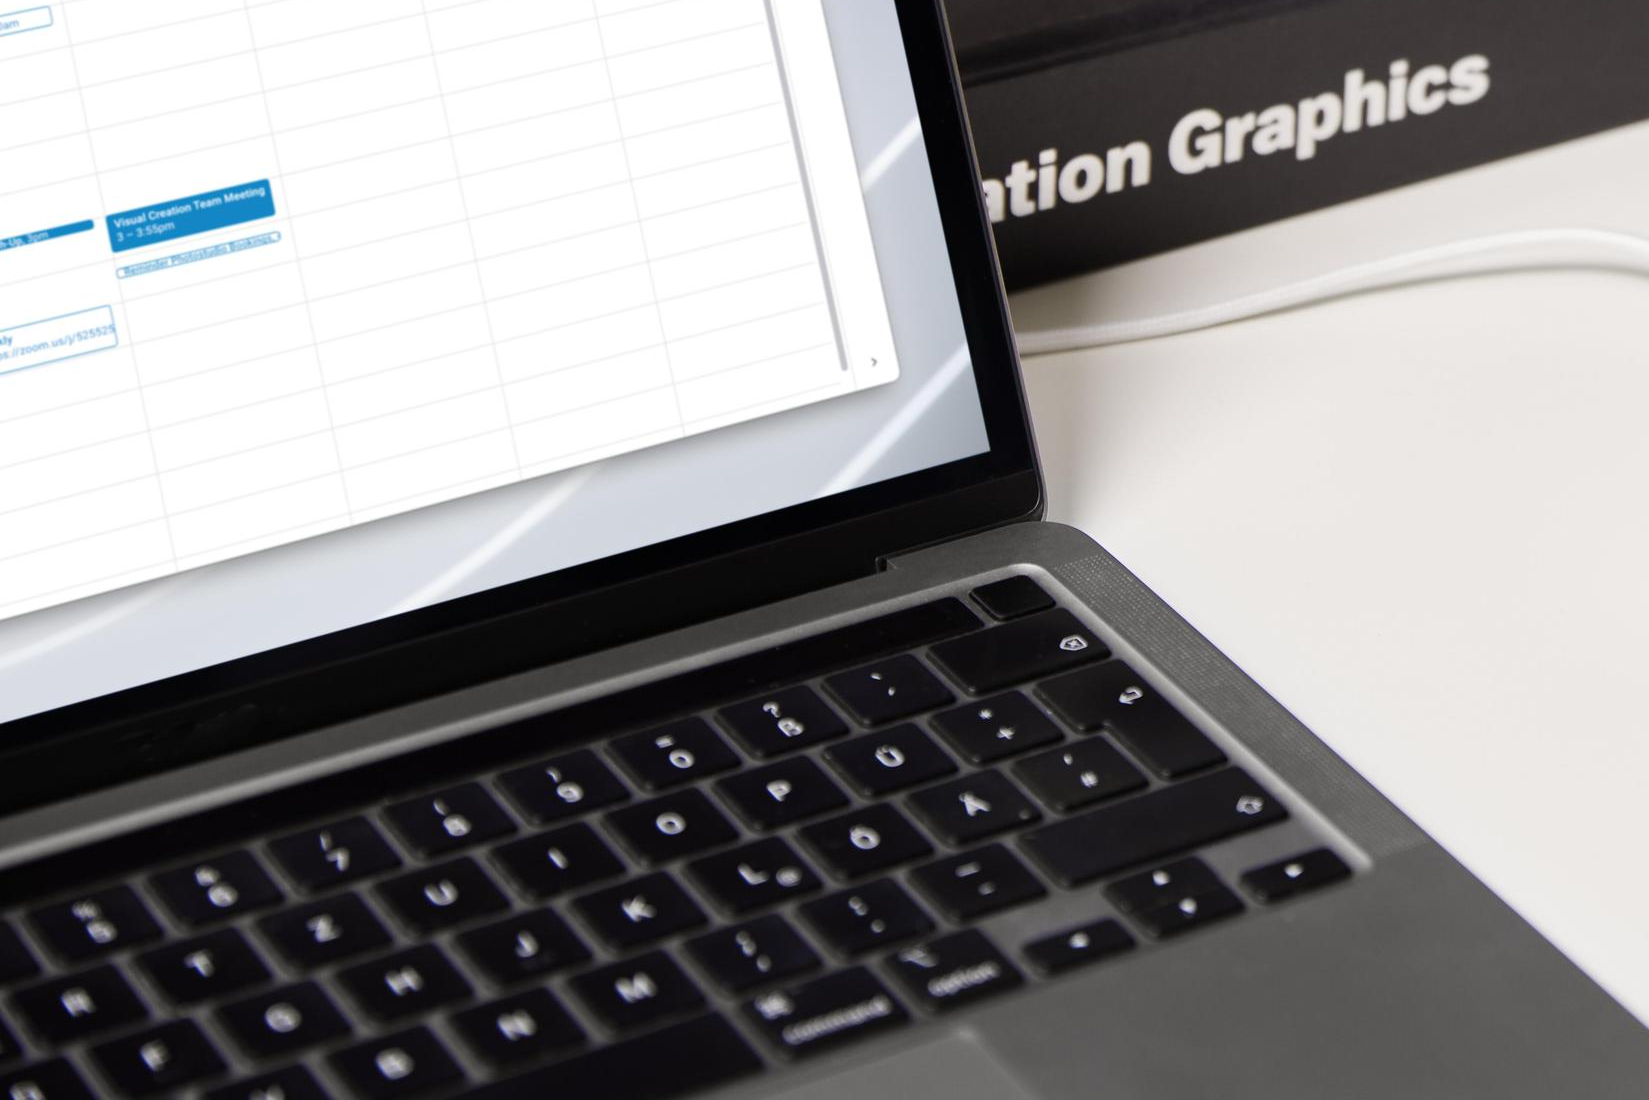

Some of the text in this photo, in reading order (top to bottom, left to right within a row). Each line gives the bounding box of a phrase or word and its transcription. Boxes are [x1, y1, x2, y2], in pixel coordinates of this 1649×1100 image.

[1167, 53, 1491, 176] Graphics
[114, 186, 266, 229] Visual Creation Team Meeting
[116, 232, 125, 242] 3
[556, 781, 585, 803] 9
[766, 778, 793, 802] P
[655, 811, 687, 836] O
[325, 847, 350, 872] 7
[736, 862, 770, 886] L
[422, 878, 460, 907] U
[620, 893, 658, 923] K
[305, 912, 343, 944] Z
[515, 928, 540, 958] J
[182, 947, 217, 979] T
[384, 965, 424, 997] H
[614, 970, 659, 1004] M
[495, 1007, 539, 1043] N
